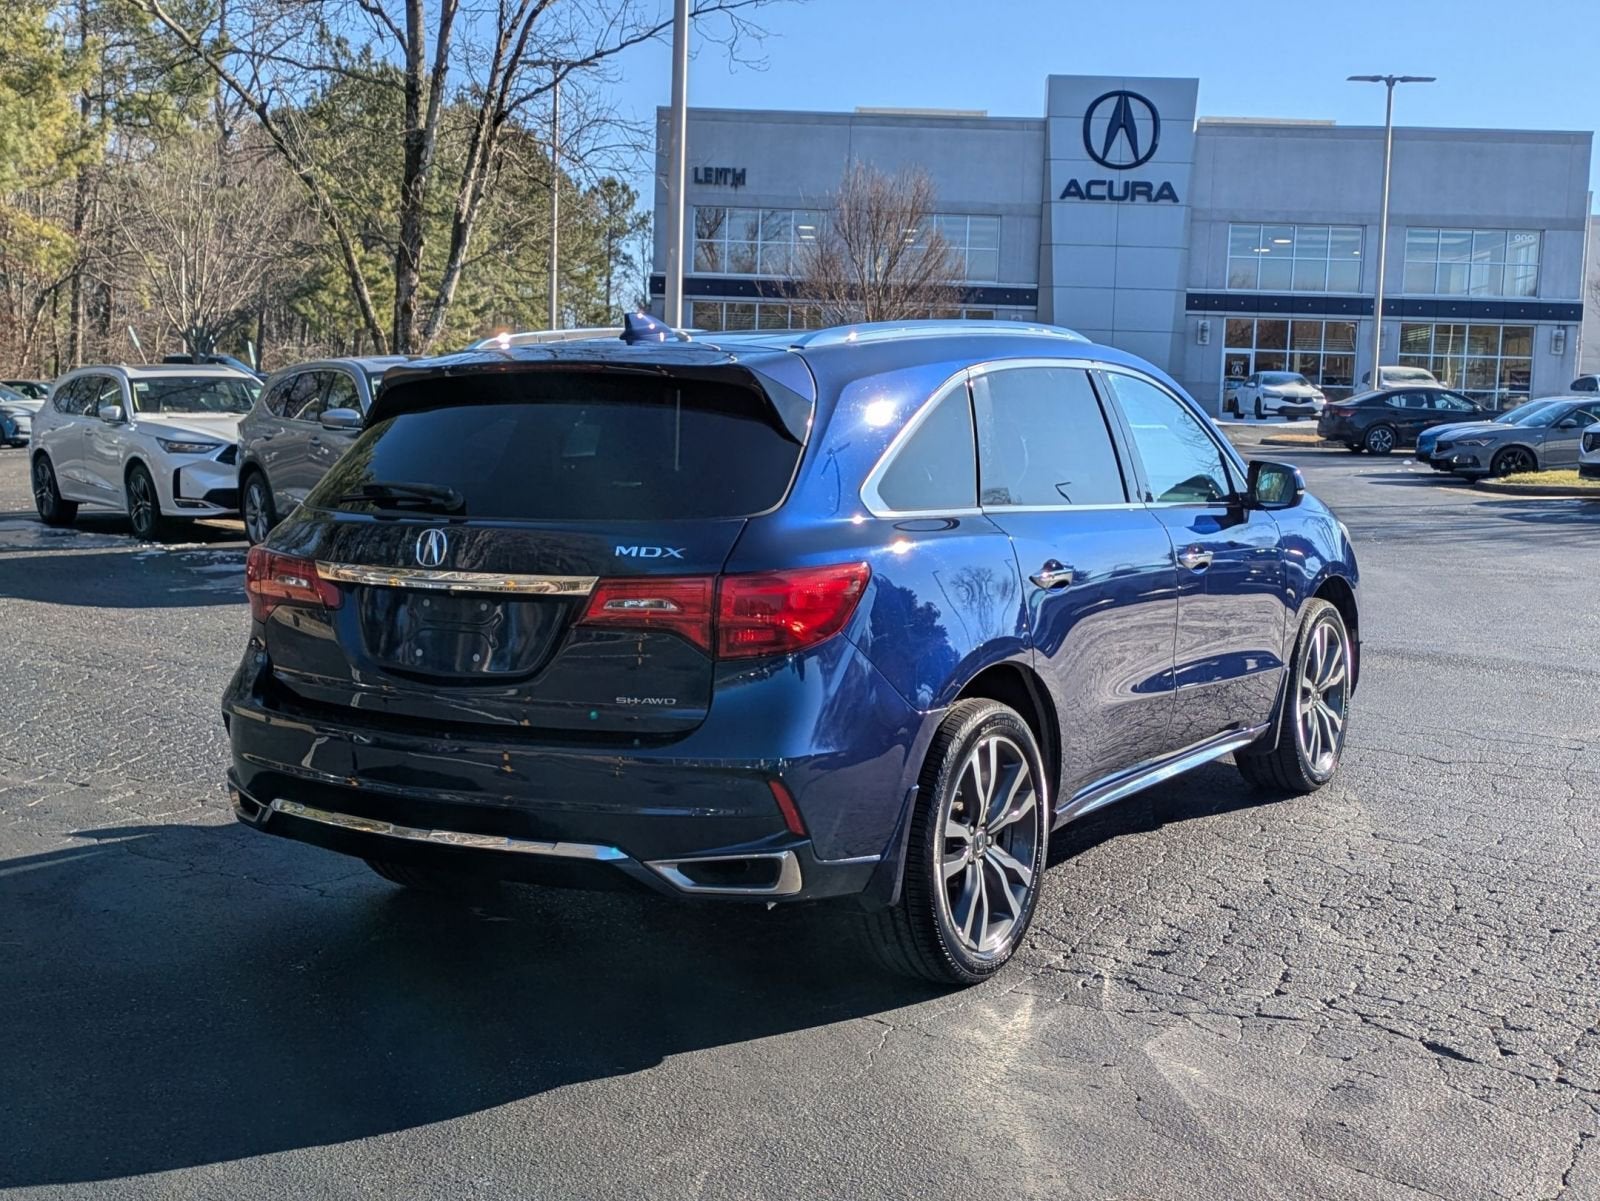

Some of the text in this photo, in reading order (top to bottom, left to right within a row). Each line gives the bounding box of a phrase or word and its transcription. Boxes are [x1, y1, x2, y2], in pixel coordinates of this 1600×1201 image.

[693, 166, 746, 187] LEITH
[1059, 178, 1180, 203] ACURA
[615, 545, 687, 559] MDX
[615, 696, 677, 705] SH-AWD
